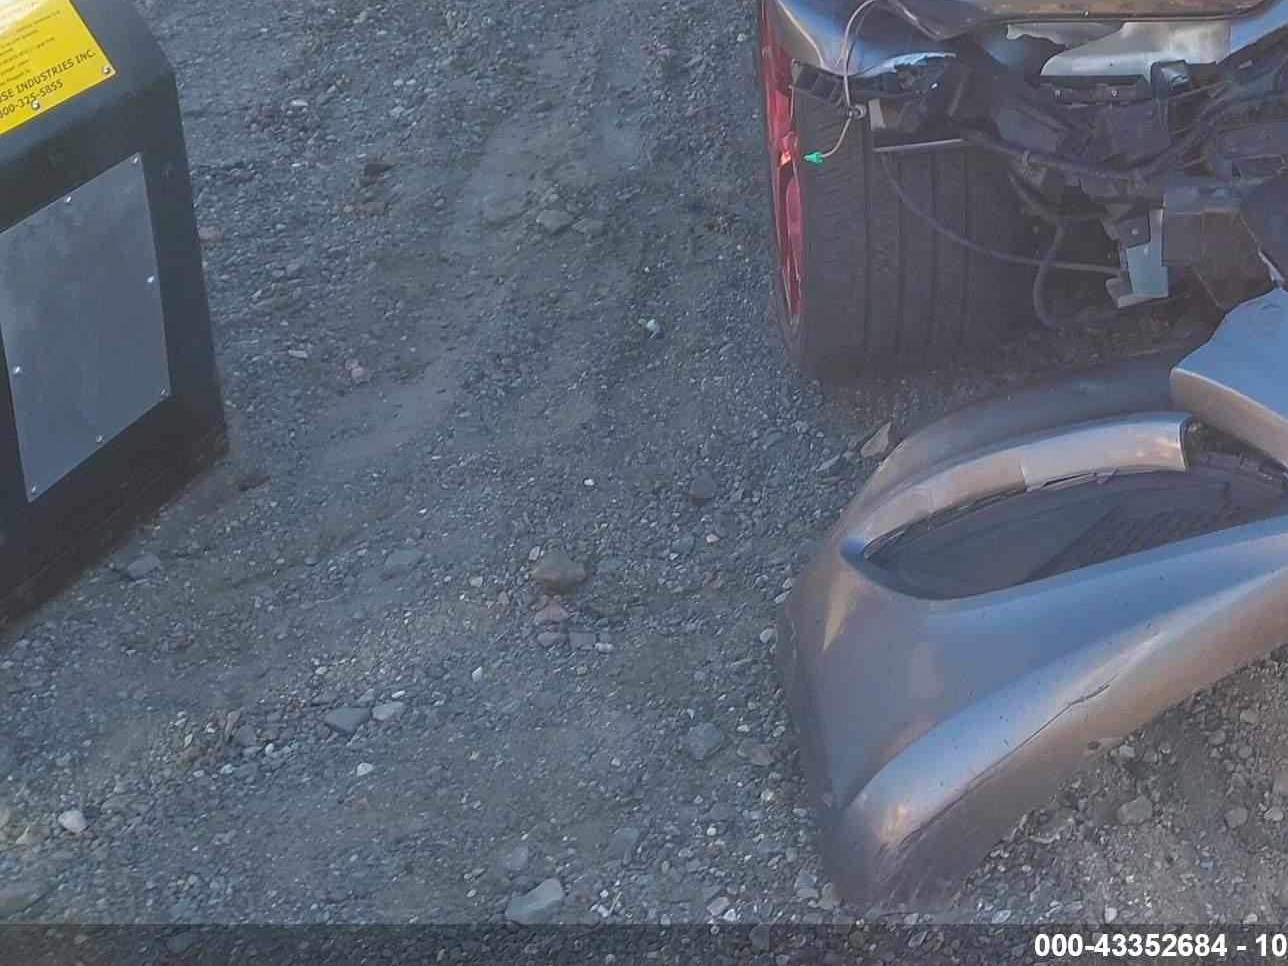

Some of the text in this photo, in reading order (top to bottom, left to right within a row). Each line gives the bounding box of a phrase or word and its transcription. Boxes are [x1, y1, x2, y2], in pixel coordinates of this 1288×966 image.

[0, 88, 15, 103] SE
[16, 58, 74, 94] INDUSTRIES
[74, 48, 96, 64] INC.
